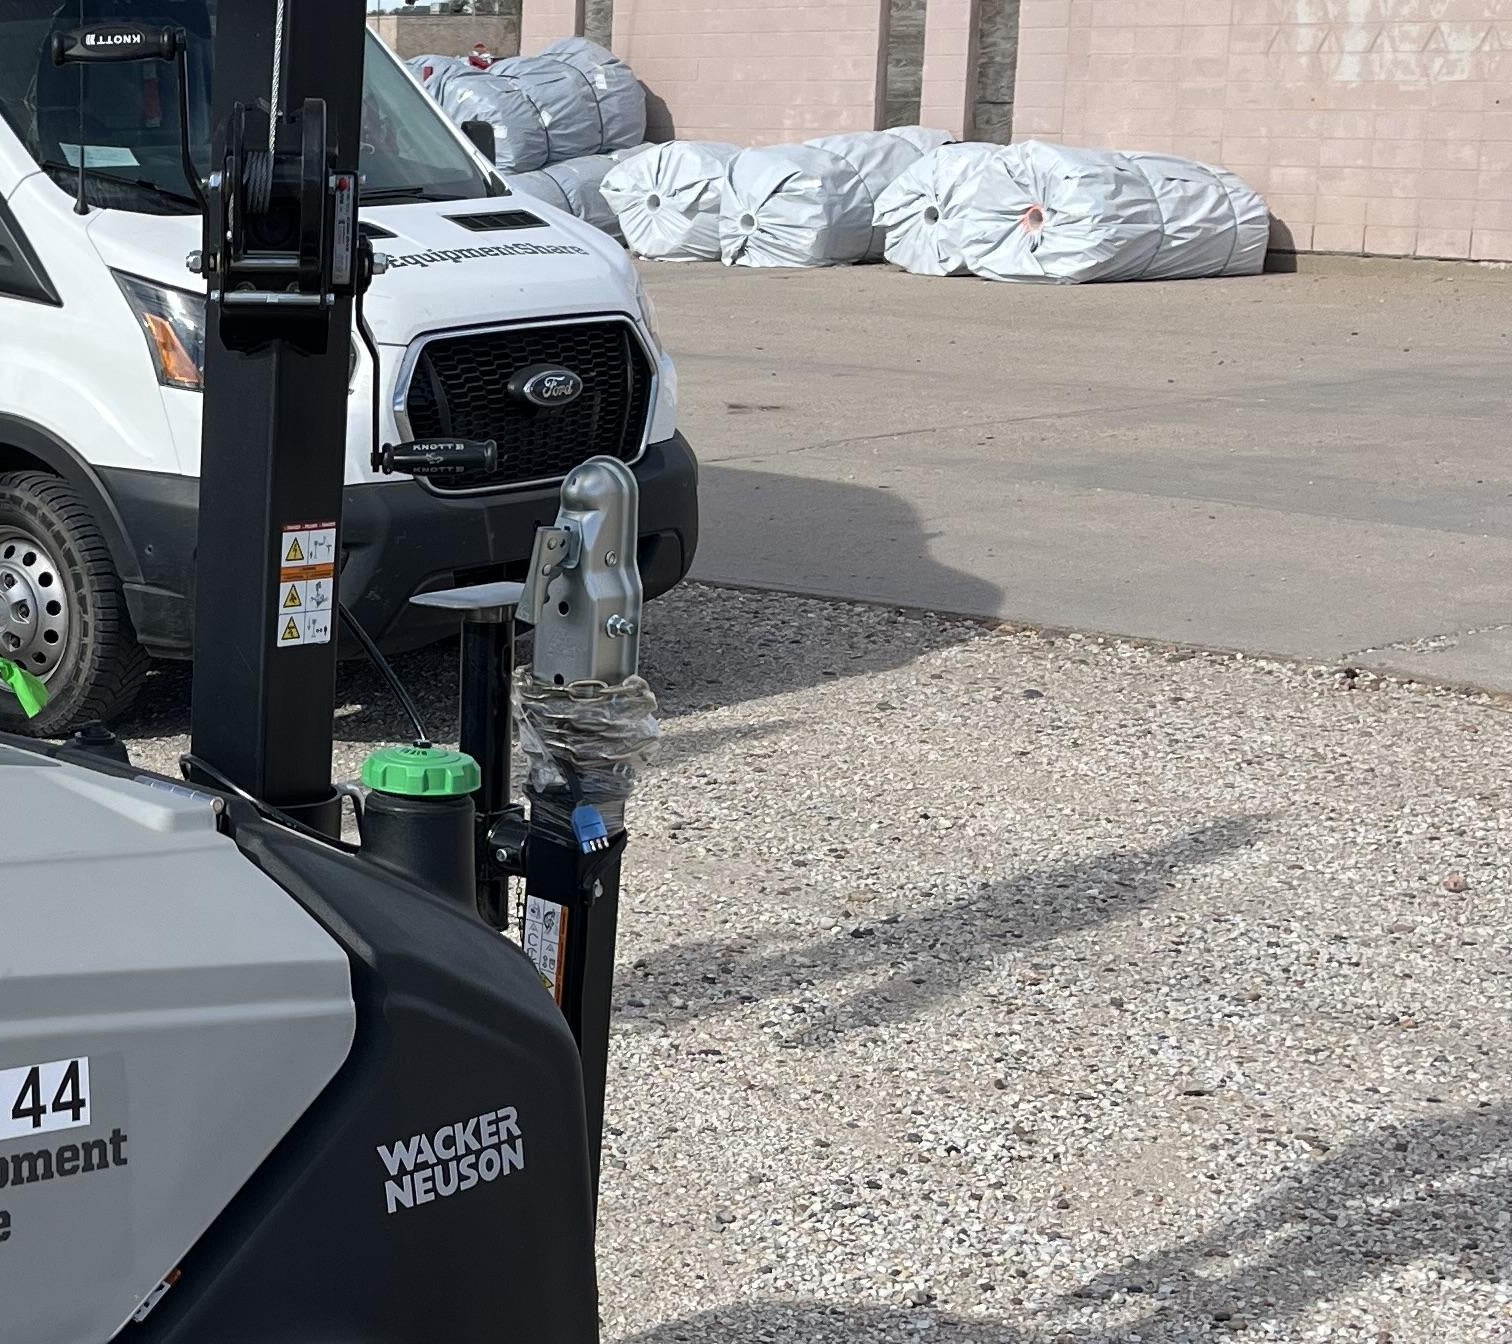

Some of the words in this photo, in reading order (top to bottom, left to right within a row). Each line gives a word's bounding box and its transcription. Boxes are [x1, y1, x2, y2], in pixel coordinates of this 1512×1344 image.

[96, 34, 141, 45] KNOTT
[387, 242, 590, 268] EquipmentShare
[542, 376, 574, 398] Ford
[376, 1106, 522, 1176] WACKER
[384, 1138, 525, 1214] NEUSON
